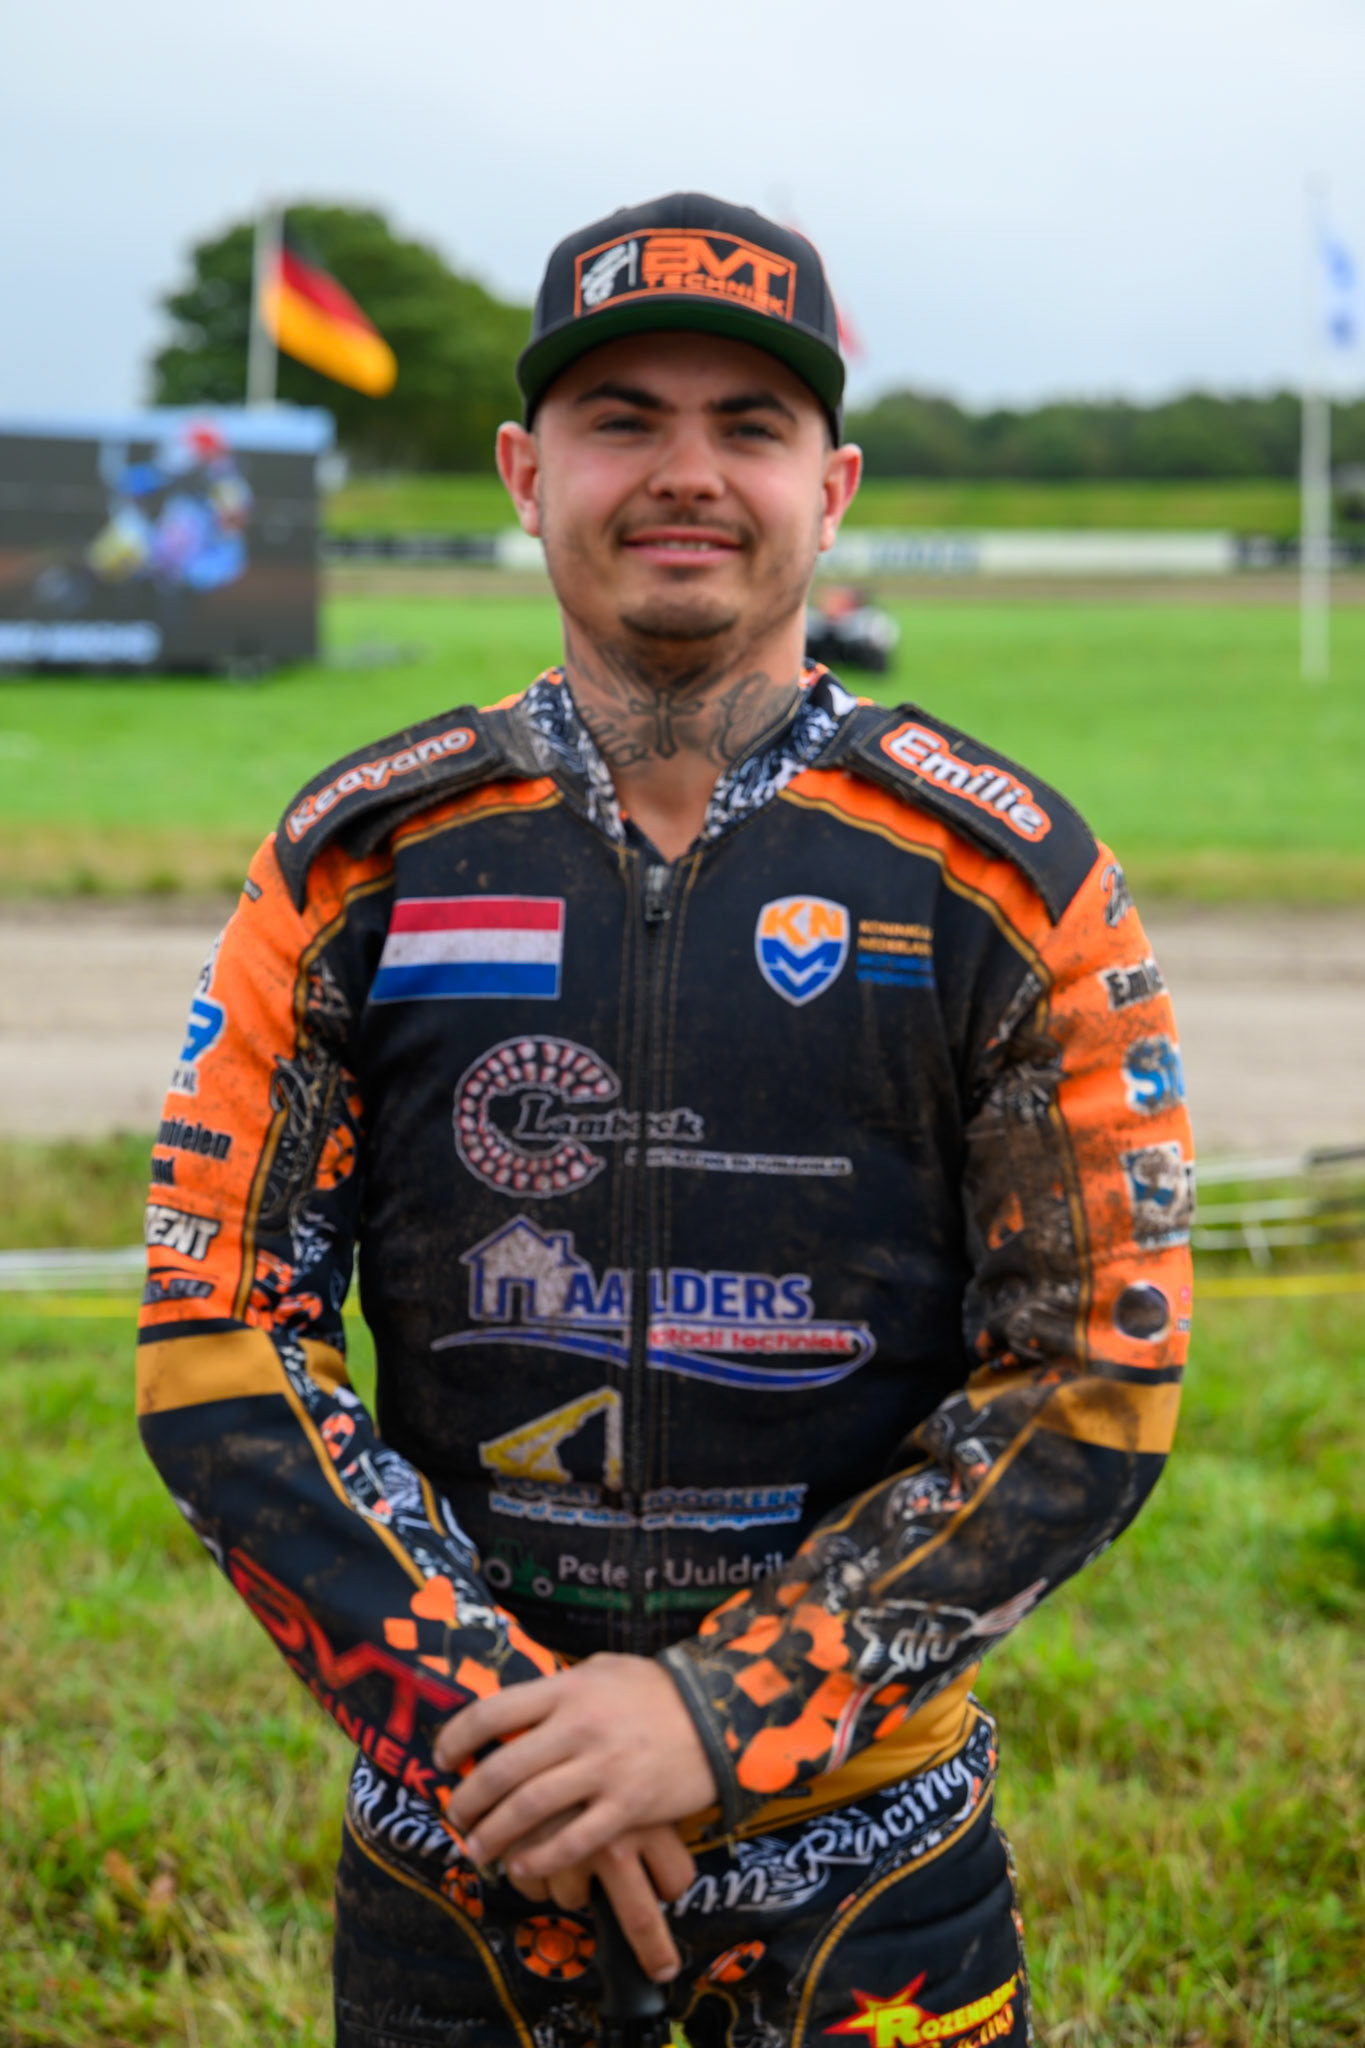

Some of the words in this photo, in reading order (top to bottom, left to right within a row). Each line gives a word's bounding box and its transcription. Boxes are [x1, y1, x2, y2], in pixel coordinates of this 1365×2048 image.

[288, 730, 472, 837] Keayano
[888, 726, 1044, 835] Emilie
[557, 1555, 658, 1590] Peter
